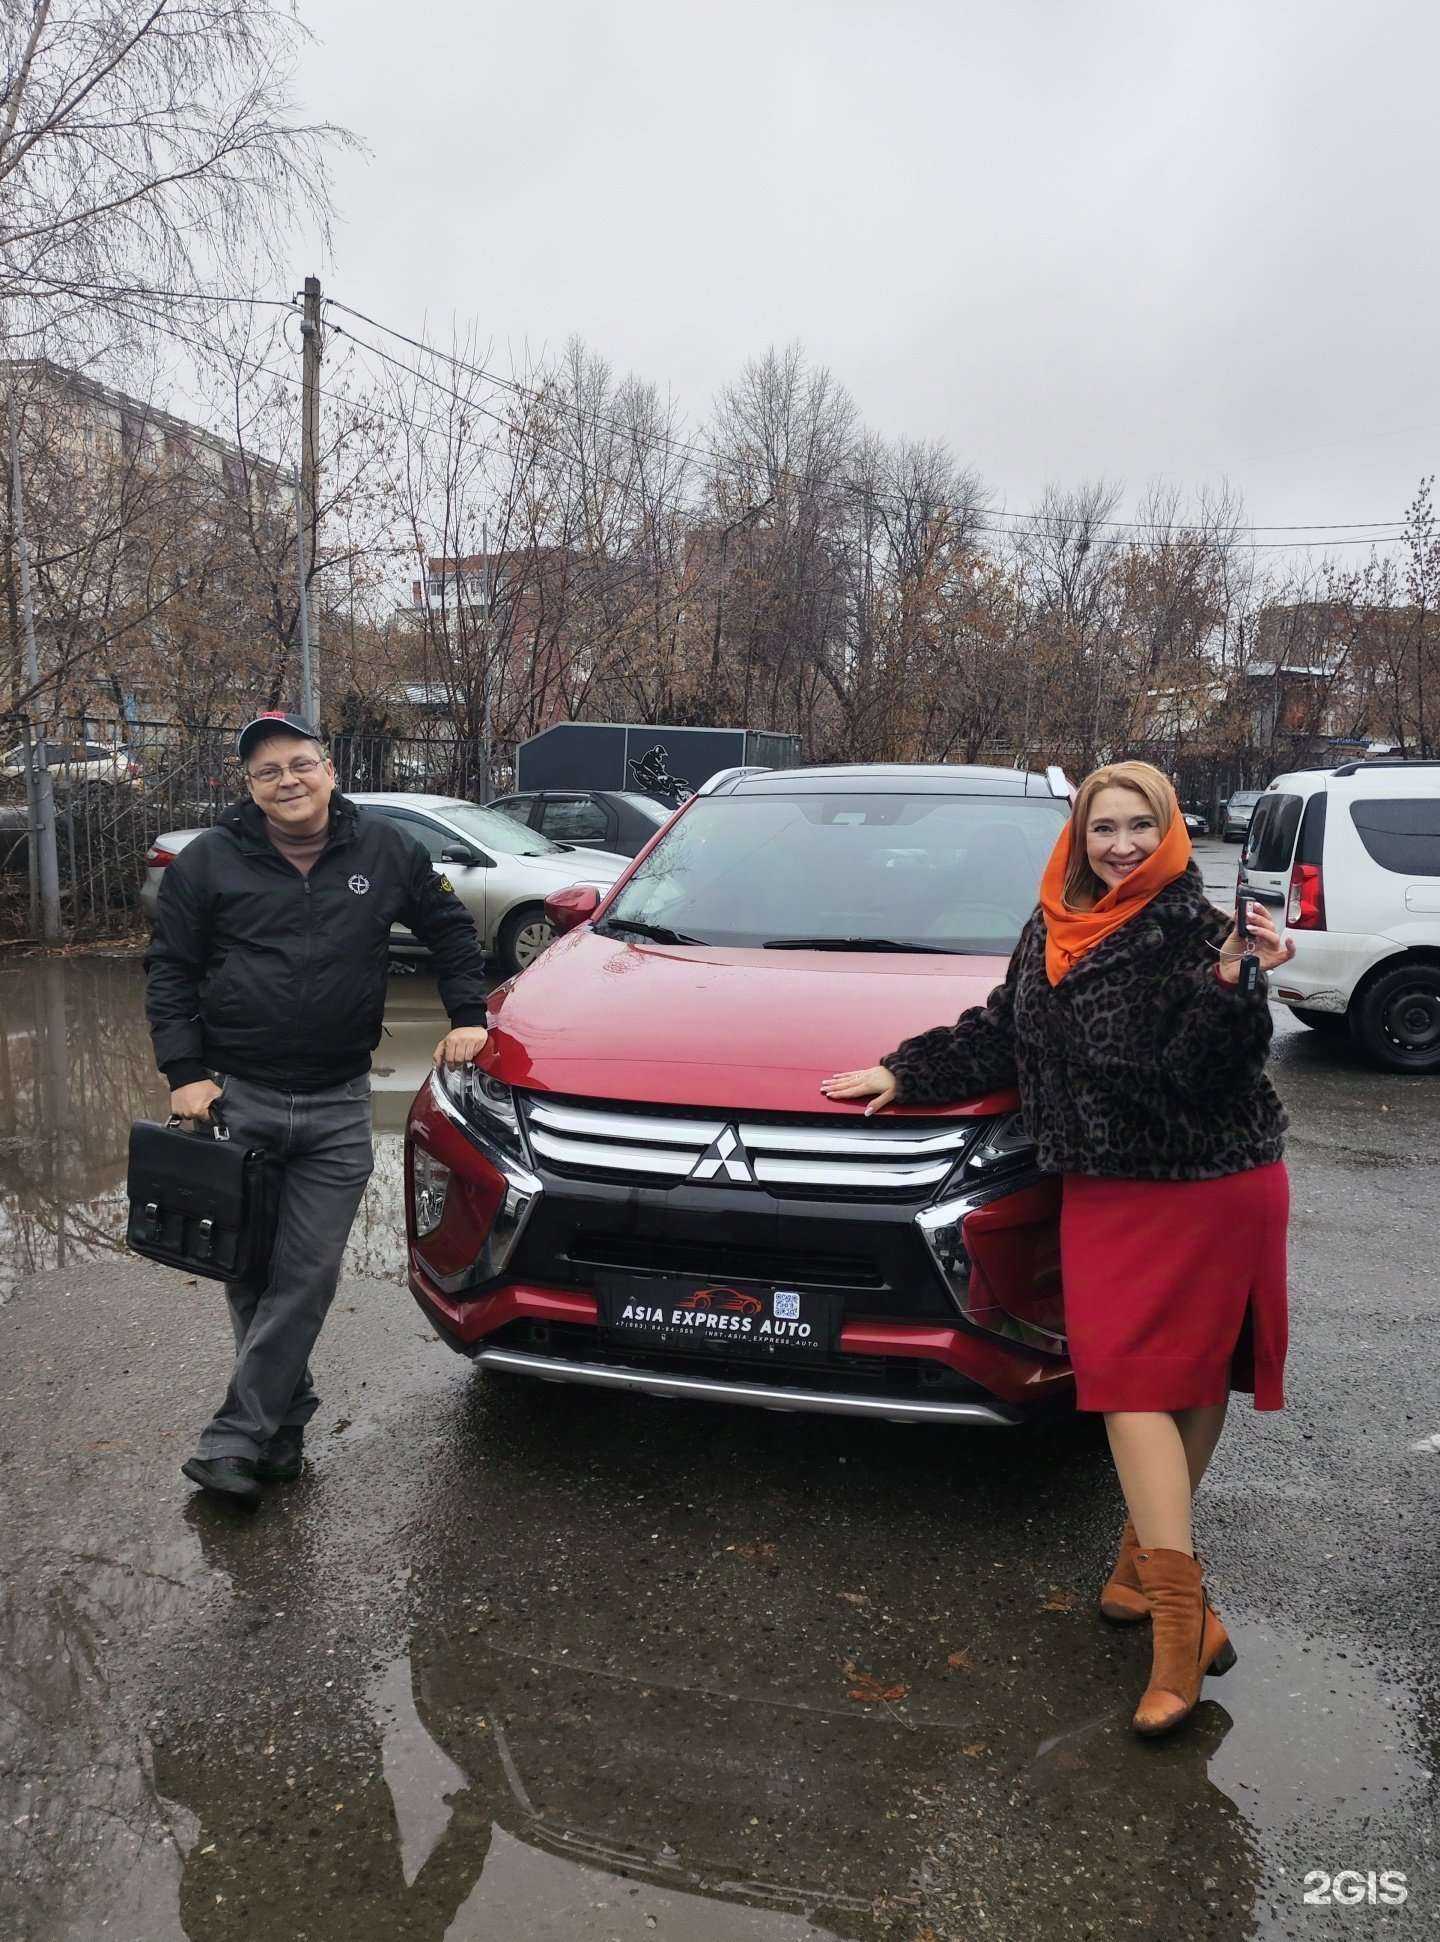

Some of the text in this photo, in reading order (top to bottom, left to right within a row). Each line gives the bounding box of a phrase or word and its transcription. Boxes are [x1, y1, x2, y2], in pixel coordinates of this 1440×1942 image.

[622, 1305, 812, 1338] ASIA EXPRESS AUTO
